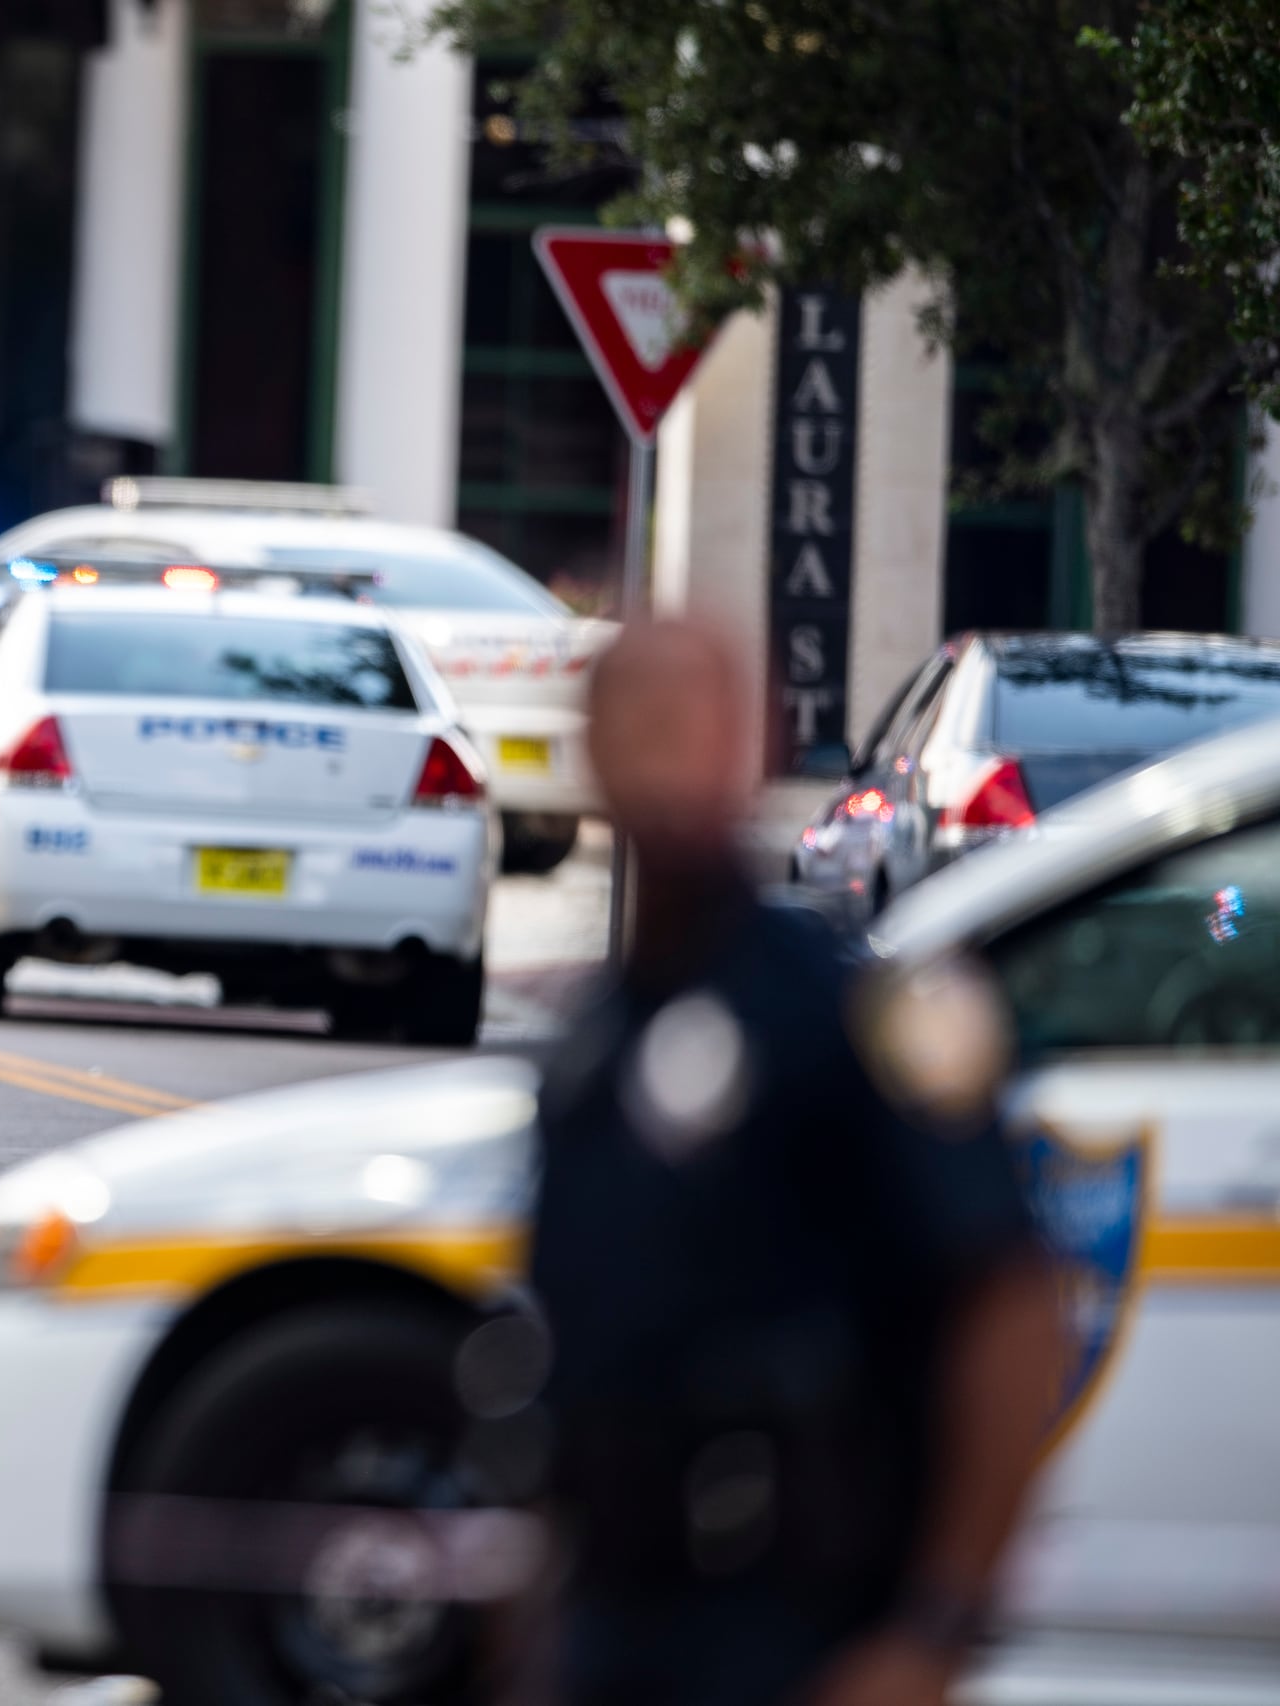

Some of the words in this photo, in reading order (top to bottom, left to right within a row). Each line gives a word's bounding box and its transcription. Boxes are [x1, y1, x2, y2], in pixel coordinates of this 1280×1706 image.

[786, 295, 844, 597] LAURA
[138, 715, 347, 752] POLICE
[783, 624, 828, 746] ST
